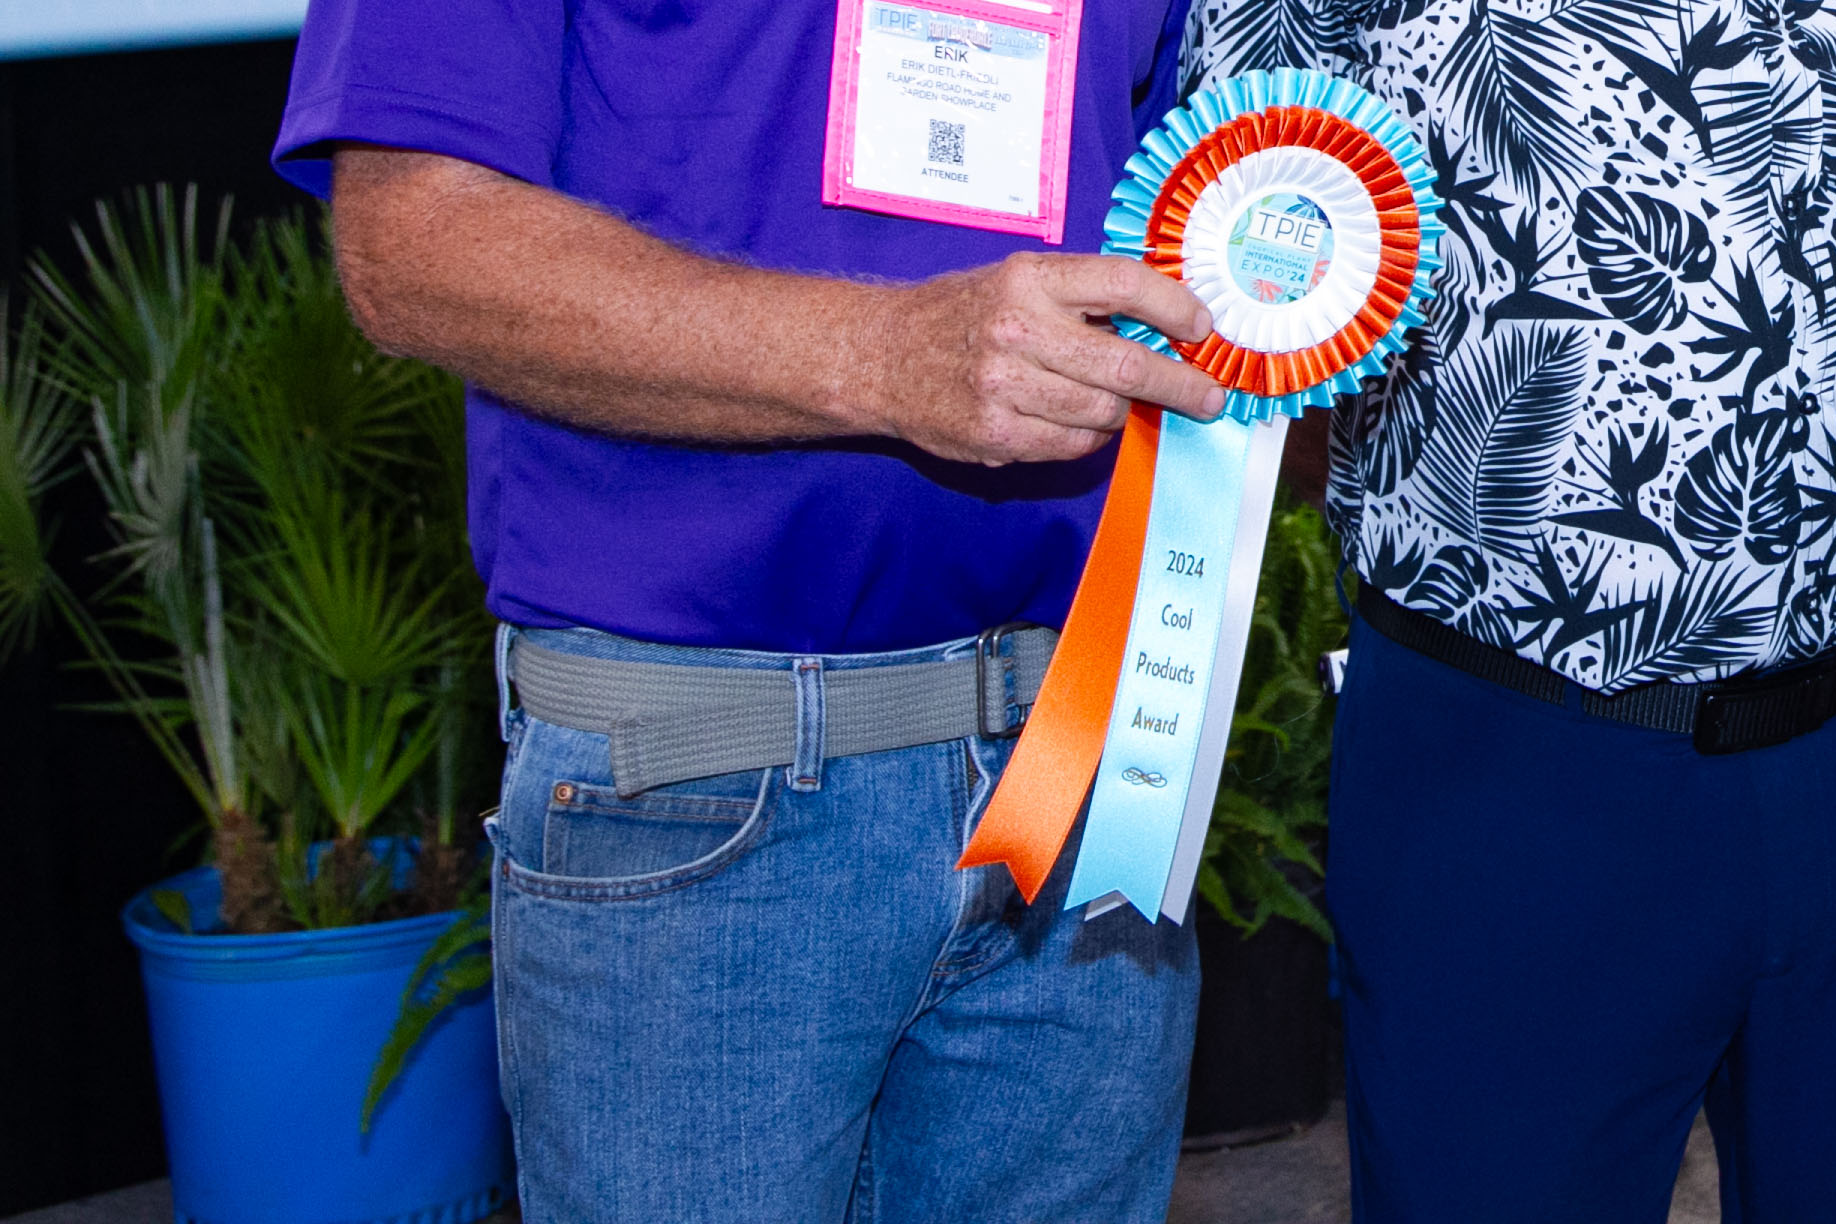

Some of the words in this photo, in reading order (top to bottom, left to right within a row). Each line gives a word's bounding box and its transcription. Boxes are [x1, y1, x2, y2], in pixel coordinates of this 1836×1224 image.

[901, 58, 925, 73] ERIK
[934, 45, 968, 63] ERIK
[936, 81, 961, 94] ROAD
[921, 167, 969, 183] ATTENDEE
[1258, 211, 1320, 248] TPIE
[1245, 250, 1307, 271] INTERNATIONAL
[1166, 549, 1204, 578] 2024
[1161, 603, 1193, 630] Cool
[1136, 651, 1195, 685] Products
[1131, 706, 1179, 736] Award
